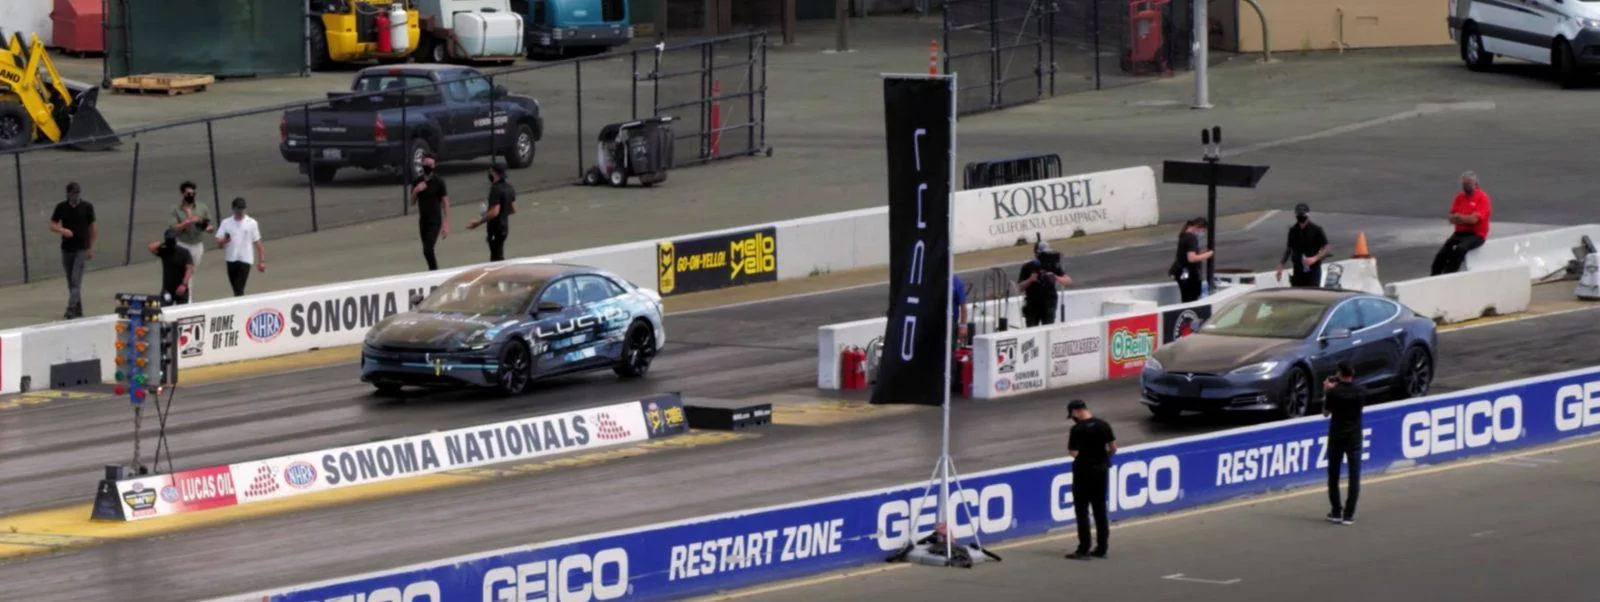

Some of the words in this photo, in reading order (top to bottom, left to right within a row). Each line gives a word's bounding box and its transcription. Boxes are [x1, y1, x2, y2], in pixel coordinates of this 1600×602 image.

[989, 220, 1047, 236] CALIFORNIA
[1049, 208, 1108, 227] CHAMPAGNE
[991, 179, 1102, 219] KORBEL
[901, 128, 927, 361] LUCID
[210, 315, 234, 333] HOME
[250, 312, 281, 338] NHRA
[291, 289, 398, 337] SONOMA
[536, 306, 624, 338] LUCID
[212, 332, 223, 350] OF
[224, 330, 240, 348] THE
[322, 438, 441, 485] SONOMA
[446, 416, 591, 467] NATIONALS
[1402, 395, 1522, 459] GEICO
[1215, 437, 1315, 486] RESTART
[1315, 428, 1372, 468] ZE
[180, 475, 216, 502] LUCAS
[216, 470, 236, 496] OIL
[1051, 454, 1180, 521] GICO
[668, 530, 773, 581] RESTART
[780, 518, 845, 561] ZONE
[483, 547, 629, 602] GEICO
